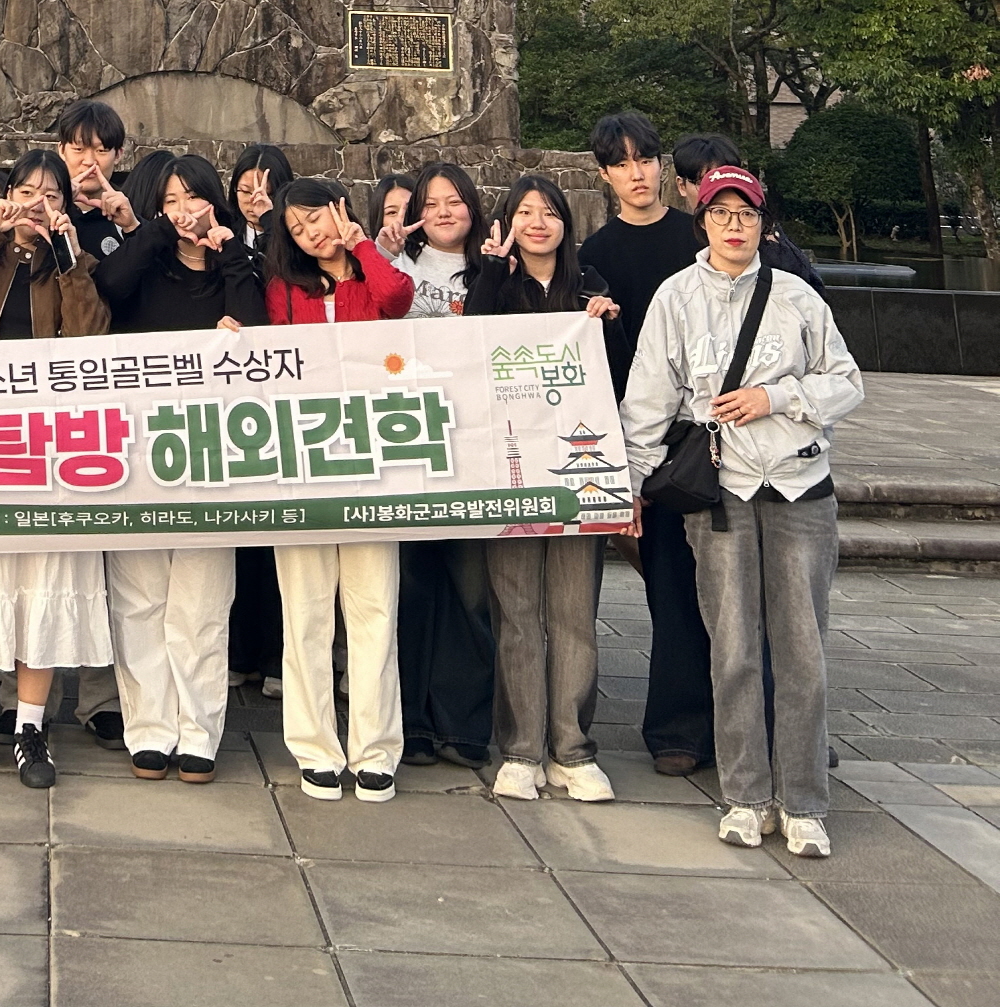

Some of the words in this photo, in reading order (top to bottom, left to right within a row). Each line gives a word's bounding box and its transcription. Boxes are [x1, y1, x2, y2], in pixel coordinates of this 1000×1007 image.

[48, 353, 204, 393] 통일골든벨
[213, 347, 304, 385] 수상자
[523, 384, 540, 392] CITY
[540, 361, 587, 406] 봉화
[496, 392, 542, 402] BONGHWA
[146, 391, 451, 483] 해외견학
[14, 510, 133, 527] 일본[후쿠오카,
[140, 510, 198, 526] 히라도,
[204, 509, 275, 525] 나가사키
[281, 508, 305, 524] 등]
[343, 496, 556, 523] [사]봉화군교육발전위원회
